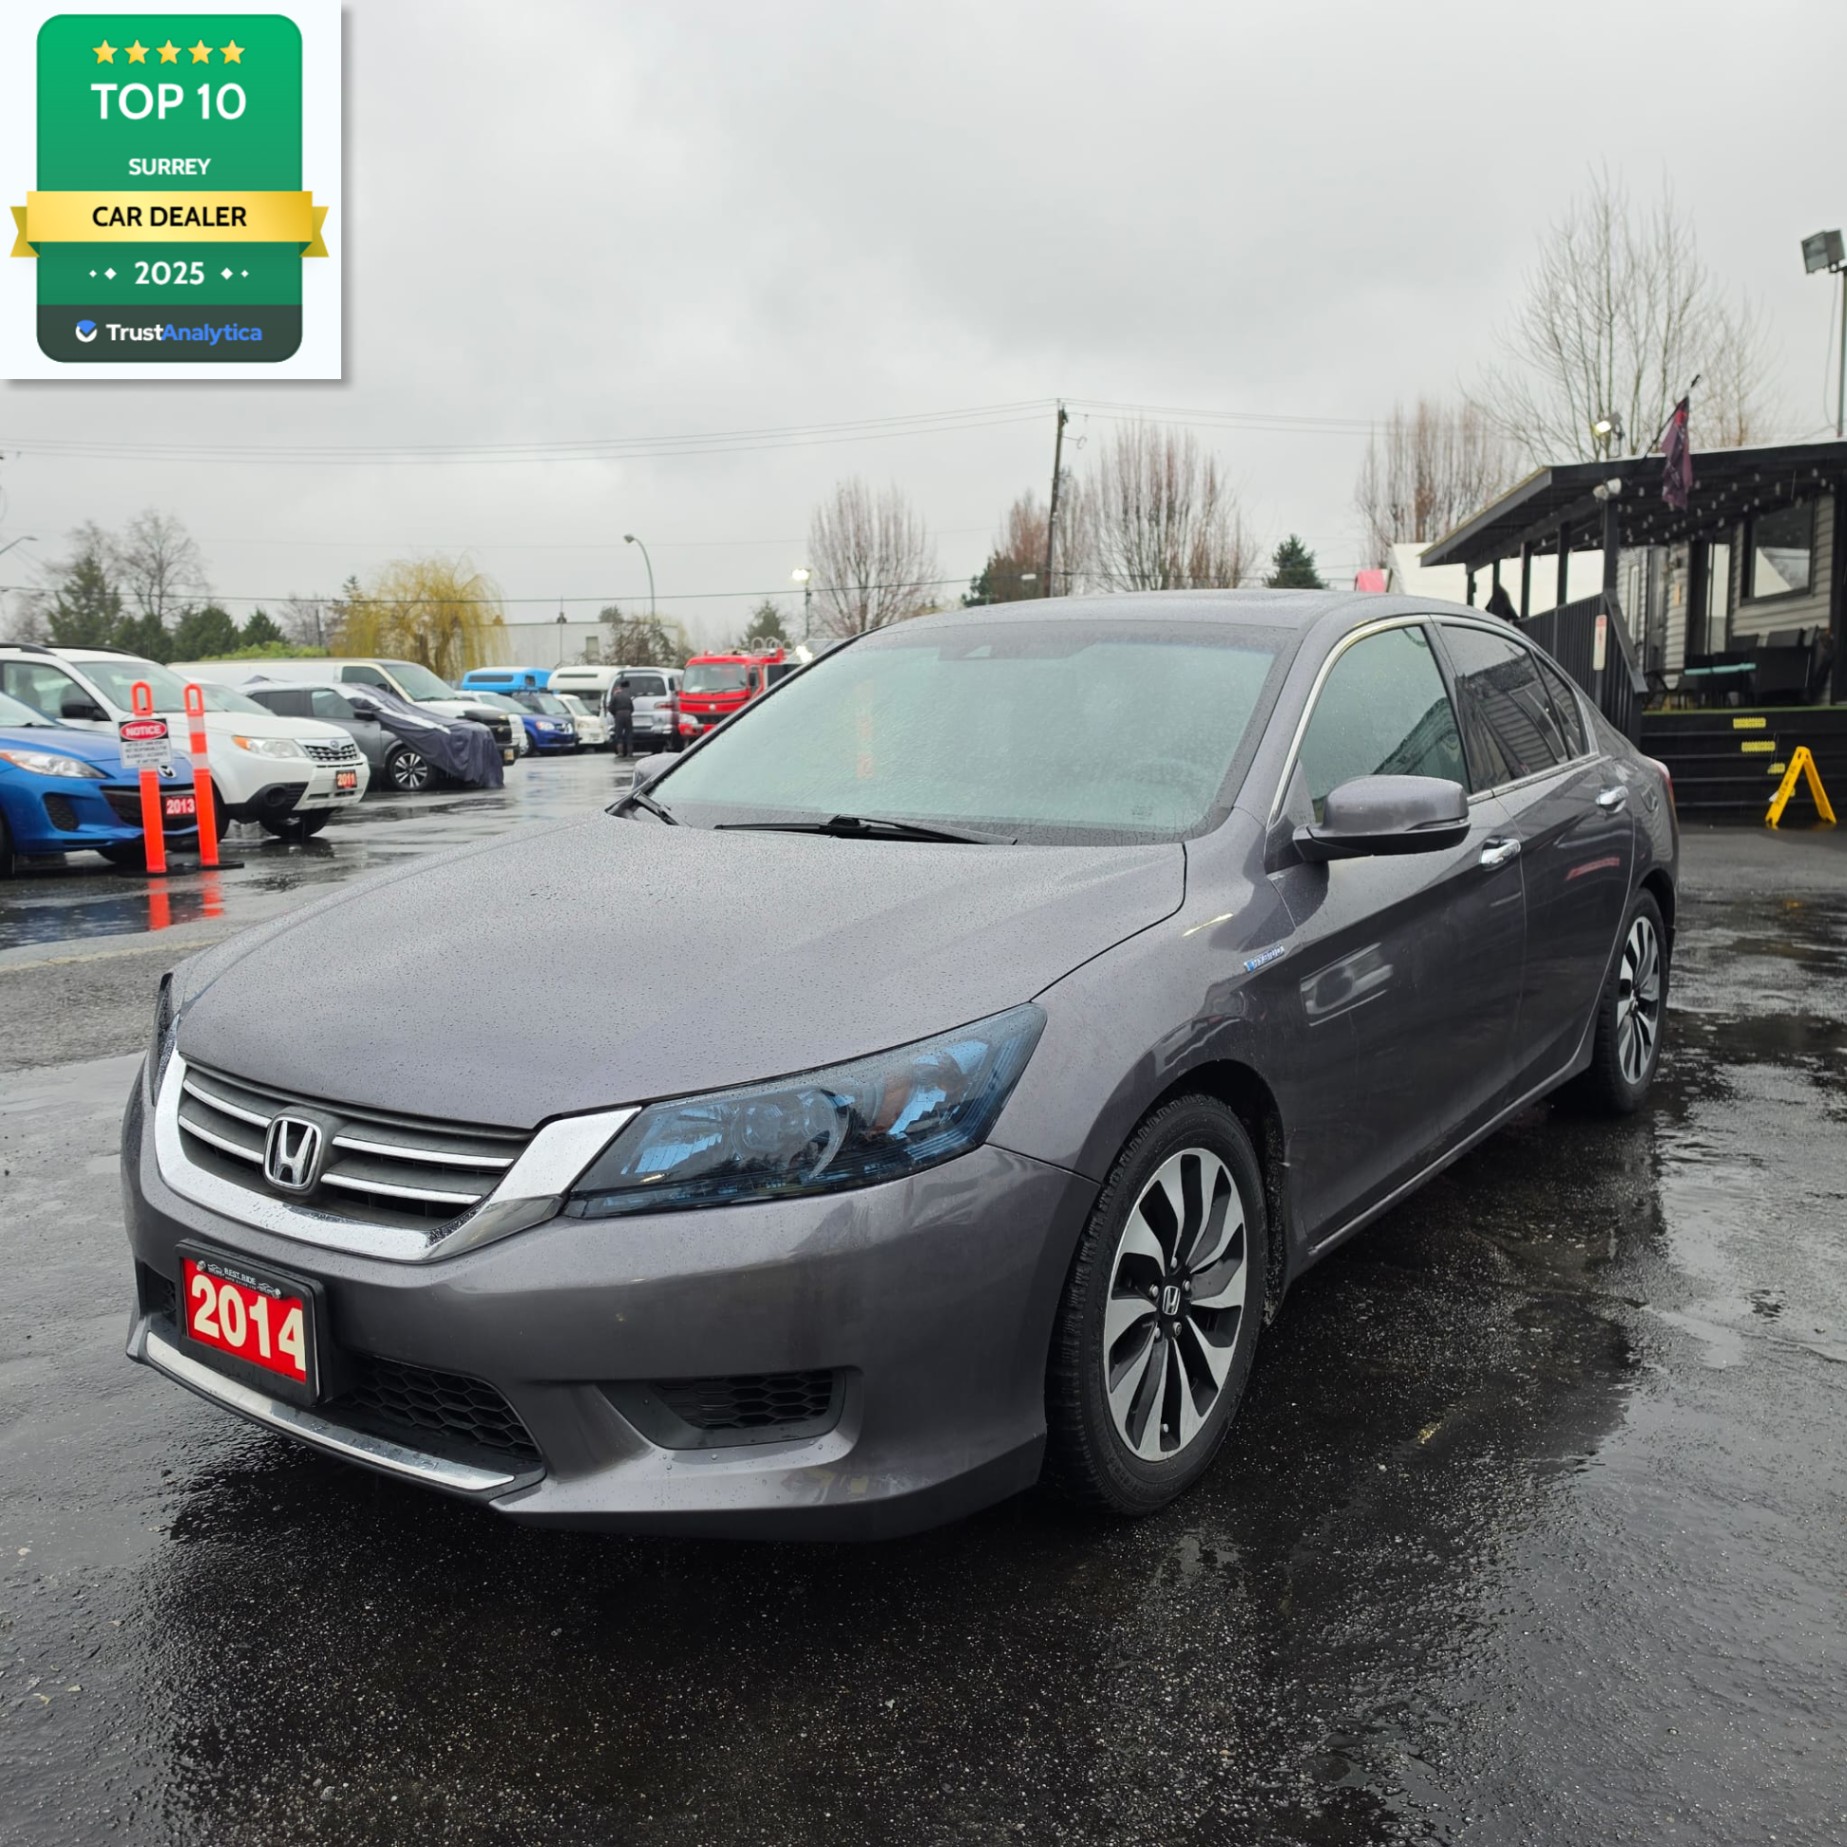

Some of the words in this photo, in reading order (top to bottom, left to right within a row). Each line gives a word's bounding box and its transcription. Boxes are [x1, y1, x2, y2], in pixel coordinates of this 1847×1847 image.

[125, 725, 161, 736] NOTICE
[166, 798, 195, 815] 2013
[192, 1275, 306, 1371] 2014
